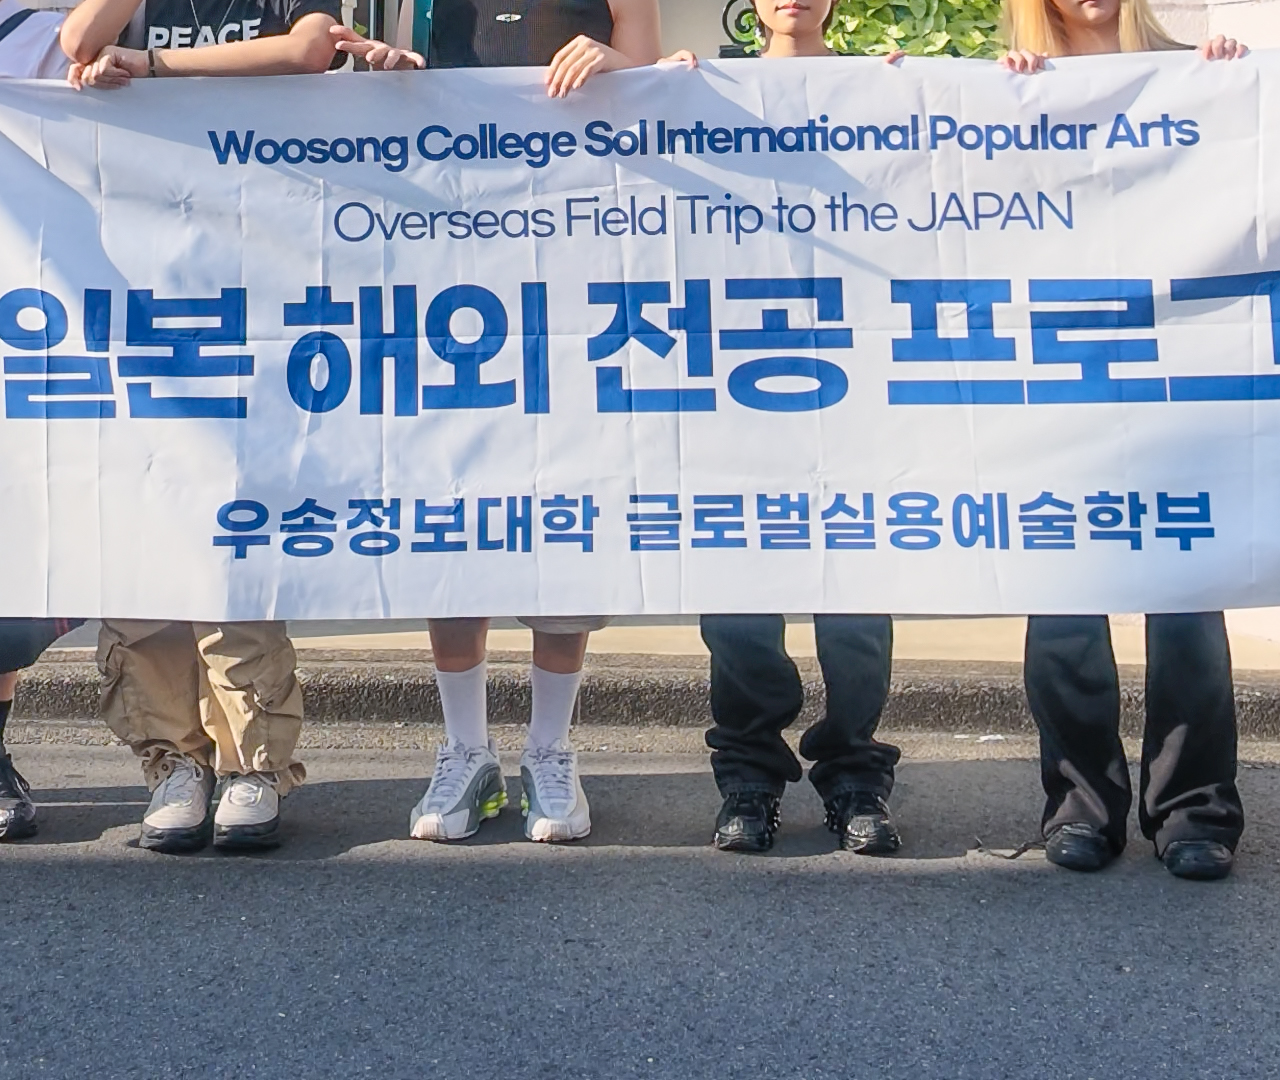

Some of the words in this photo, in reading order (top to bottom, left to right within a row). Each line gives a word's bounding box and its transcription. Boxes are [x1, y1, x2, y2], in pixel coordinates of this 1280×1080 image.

[147, 18, 261, 51] PEACE
[208, 128, 410, 172] Woosong
[416, 123, 575, 168] College
[584, 120, 648, 158] Sol
[657, 114, 920, 155] International
[930, 114, 1098, 160] Popular
[1105, 114, 1201, 149] Arts
[333, 199, 556, 243] Overseas
[566, 196, 668, 237] Field
[676, 192, 765, 245] Trip
[771, 197, 816, 233] to
[823, 193, 899, 233] the
[907, 190, 1073, 232] JAPAN
[283, 281, 549, 417] 해외
[587, 277, 854, 413] 전공
[212, 494, 601, 558] 우송정보대학
[626, 490, 1216, 552] 글로벌실용예술학부
